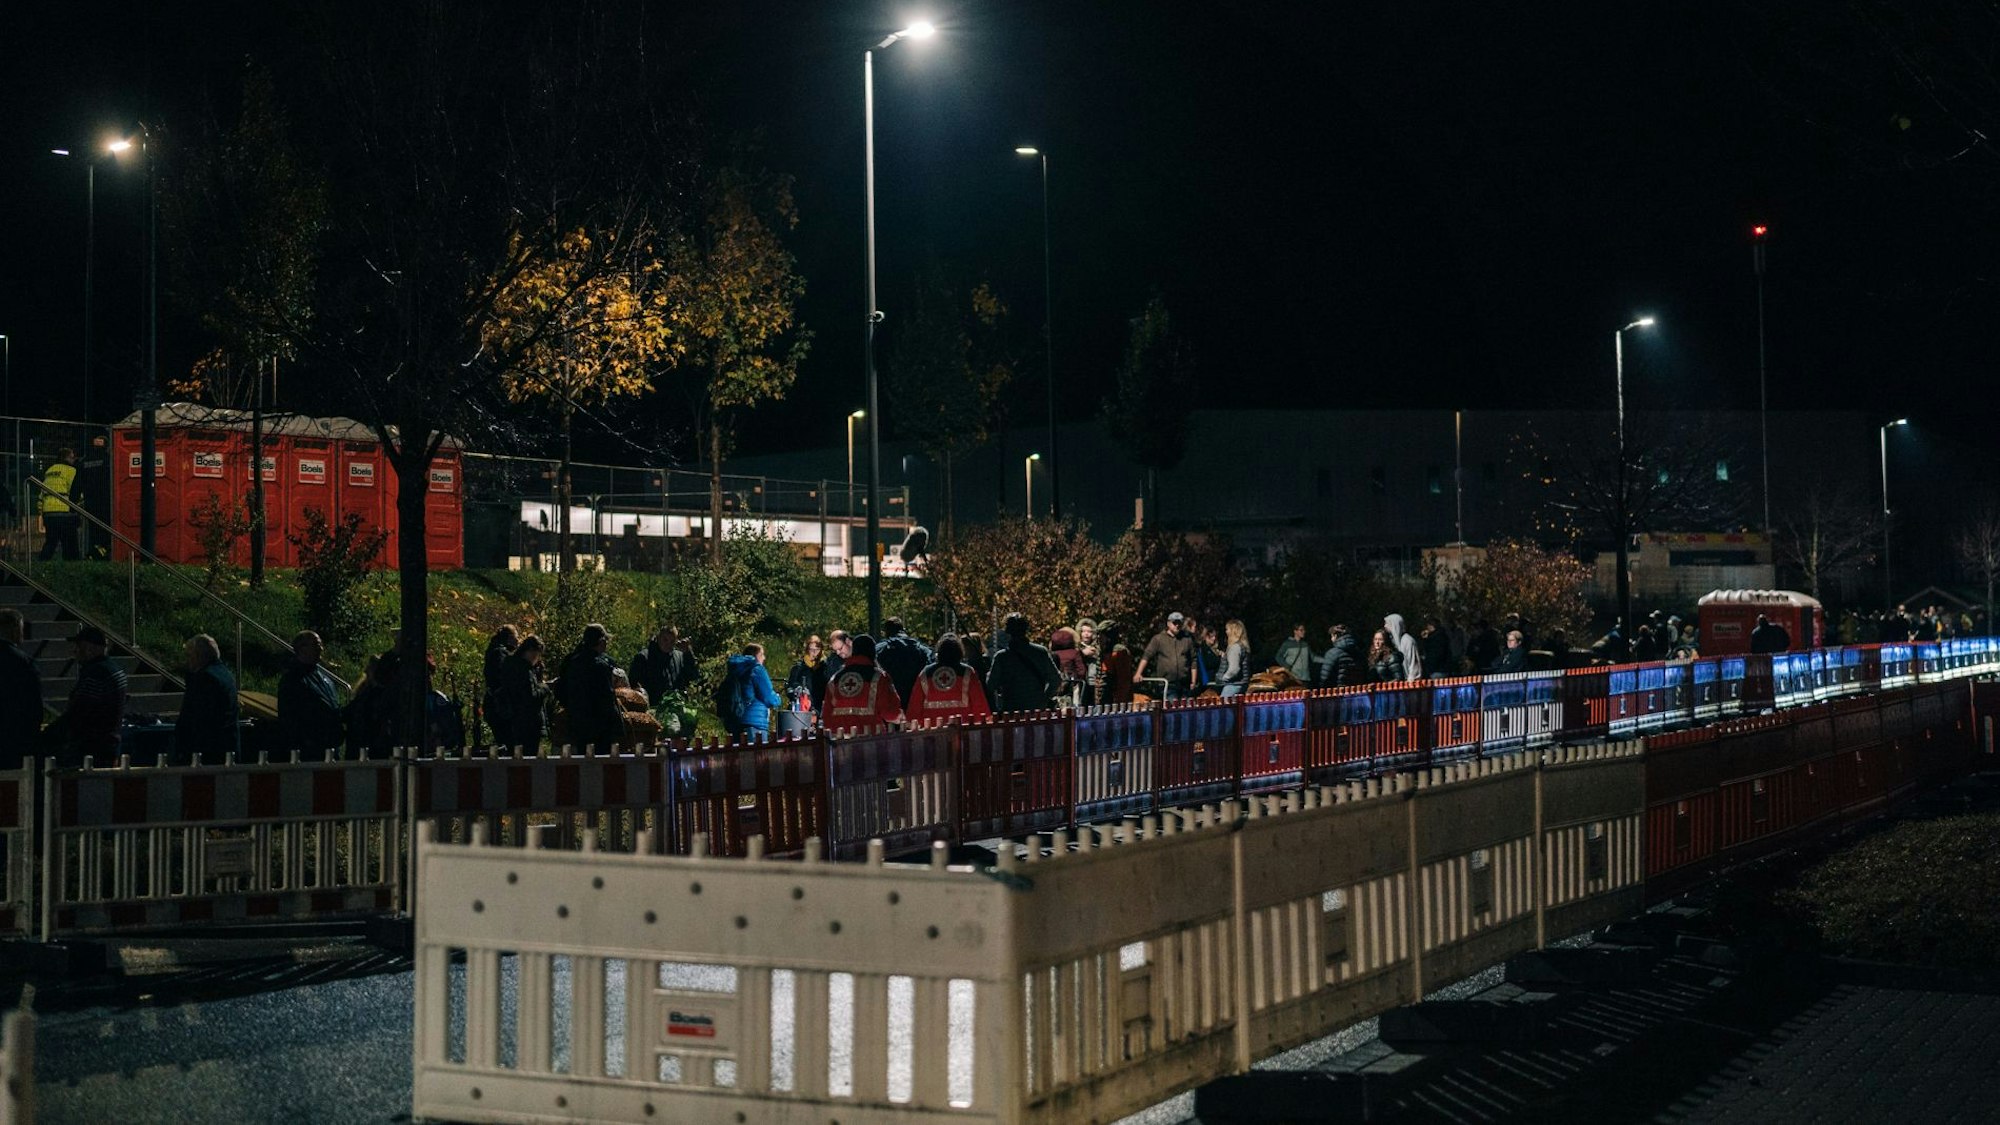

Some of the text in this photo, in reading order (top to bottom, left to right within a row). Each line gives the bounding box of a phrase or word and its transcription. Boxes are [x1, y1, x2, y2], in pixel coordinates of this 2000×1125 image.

[251, 461, 274, 469] Bels
[301, 464, 323, 473] Boels
[351, 467, 372, 475] Boels
[432, 473, 452, 482] Boels
